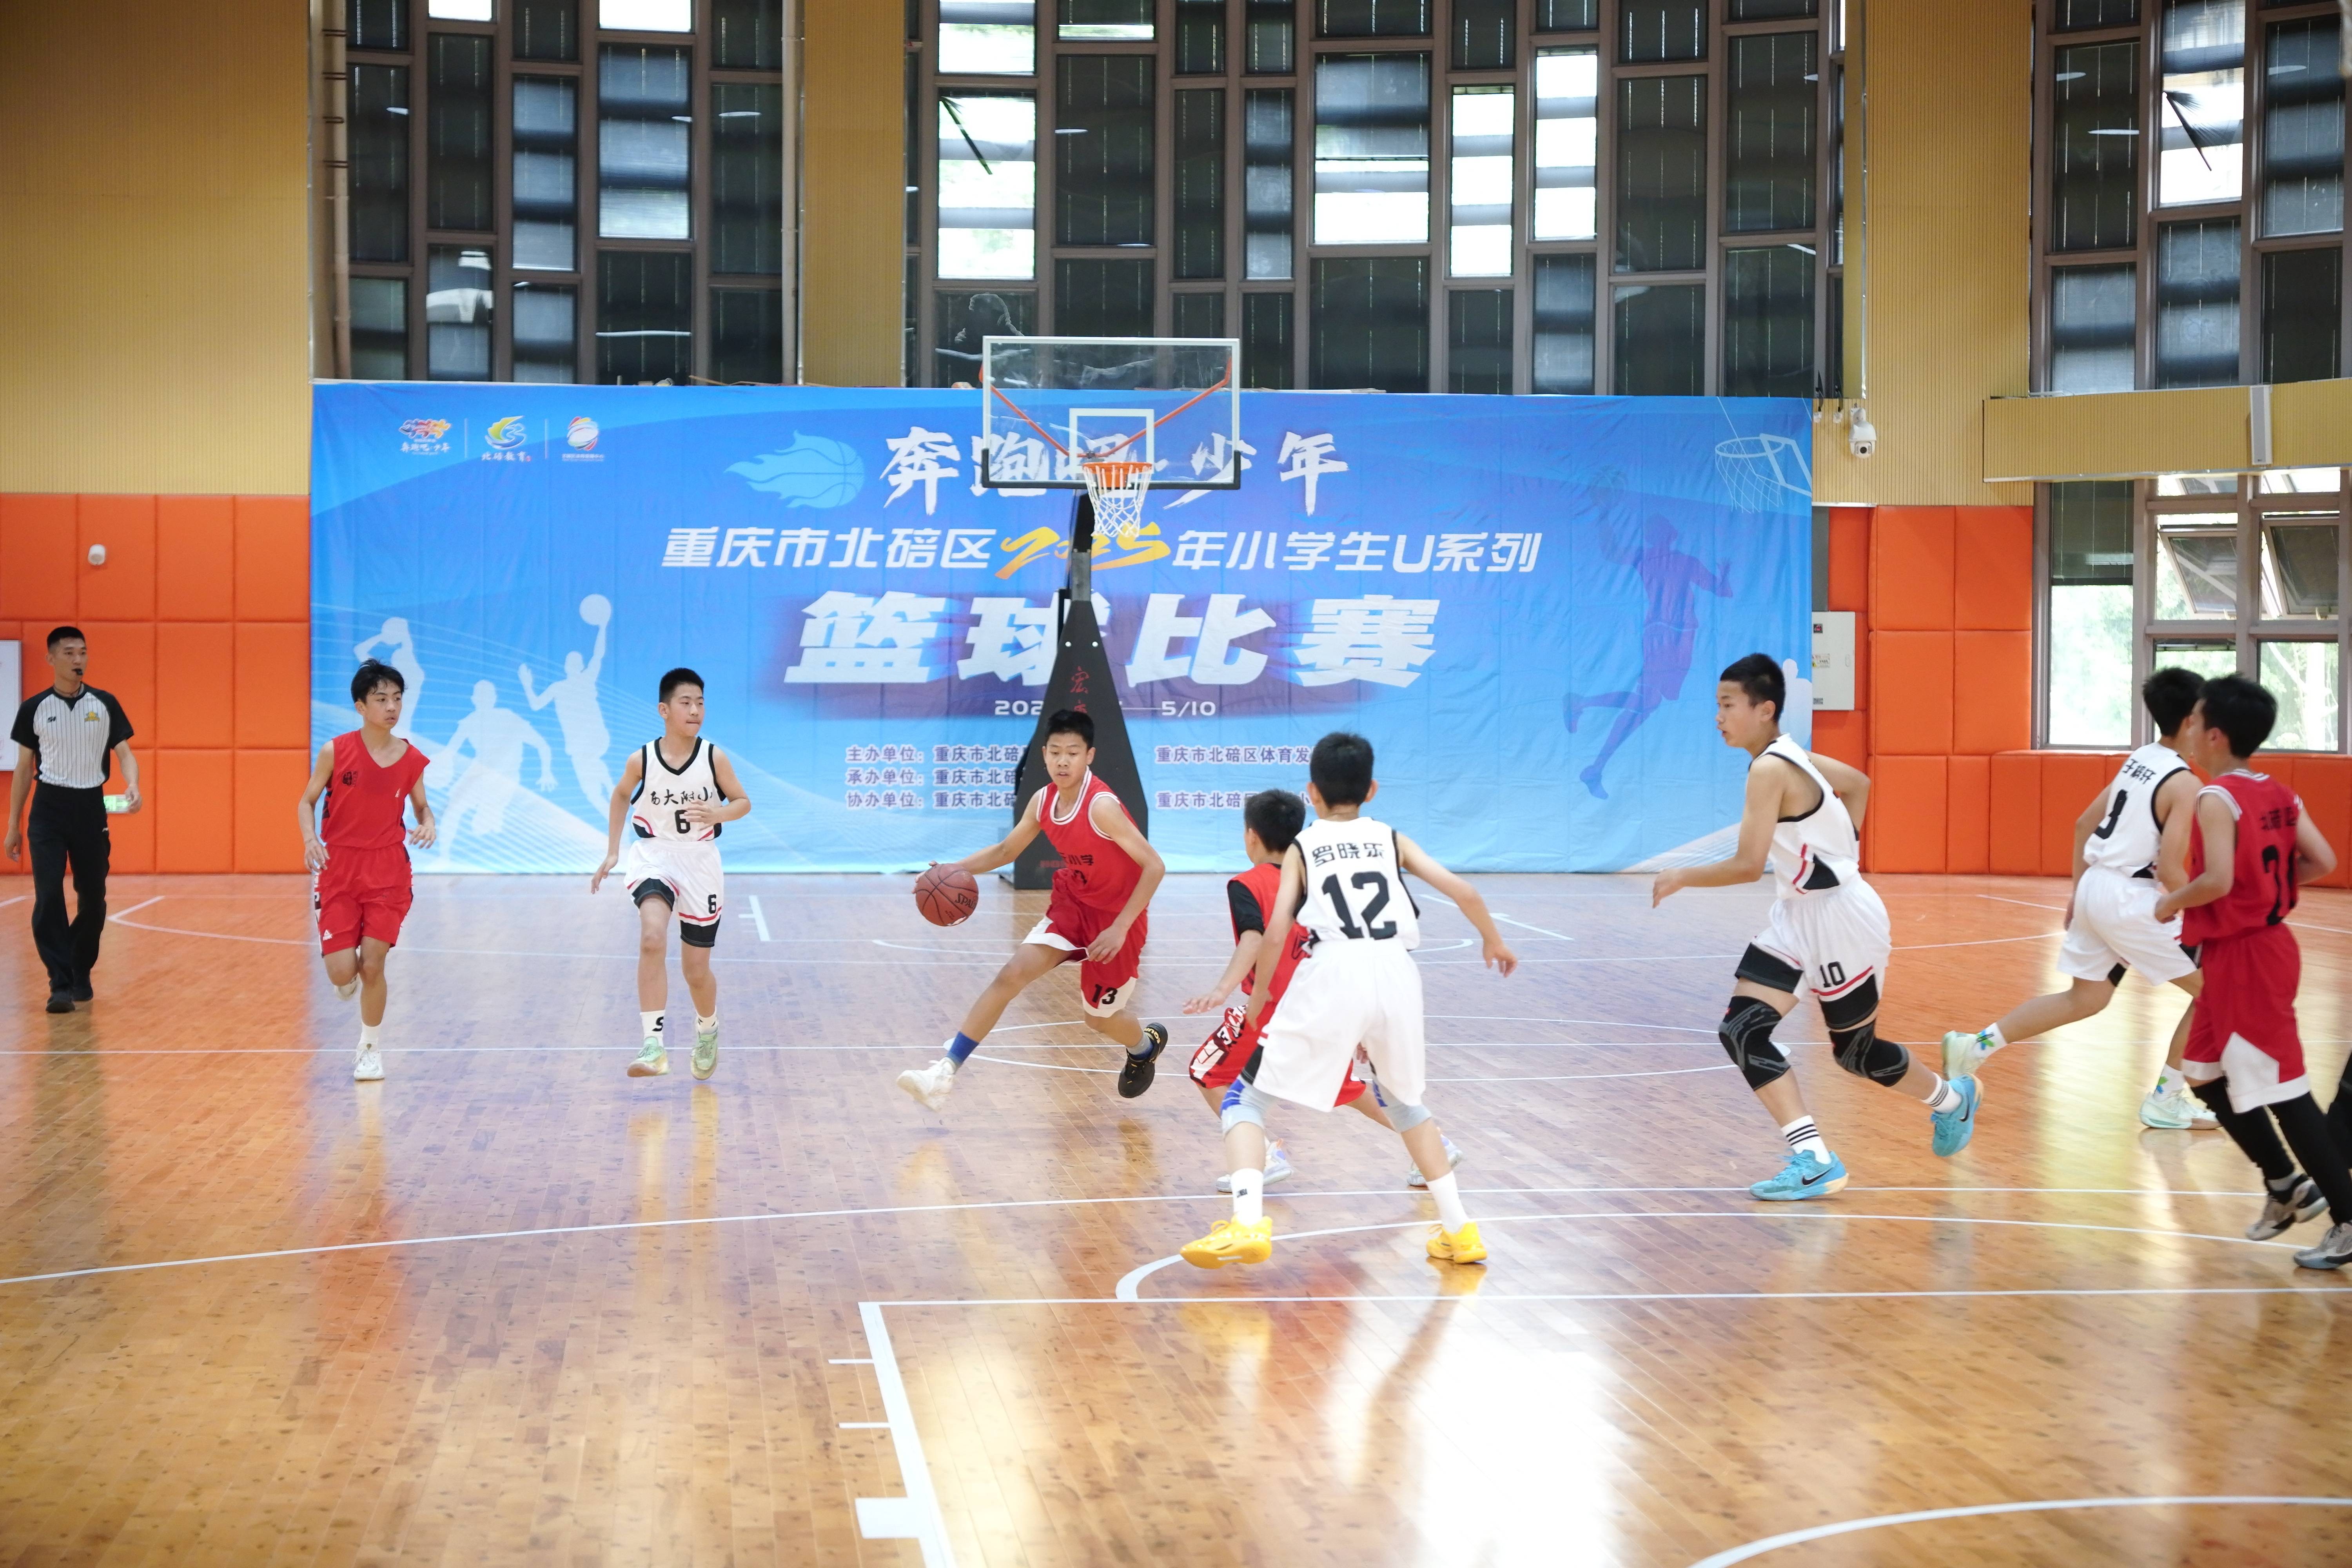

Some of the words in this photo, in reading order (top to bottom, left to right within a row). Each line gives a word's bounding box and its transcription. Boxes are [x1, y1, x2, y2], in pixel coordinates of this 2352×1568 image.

[784, 591, 1440, 689] 篮球比赛
[675, 809, 691, 834] 6
[708, 894, 717, 914] 6
[1321, 871, 1397, 940] 12
[1820, 961, 1846, 987] 10
[1091, 984, 1117, 1005] 13
